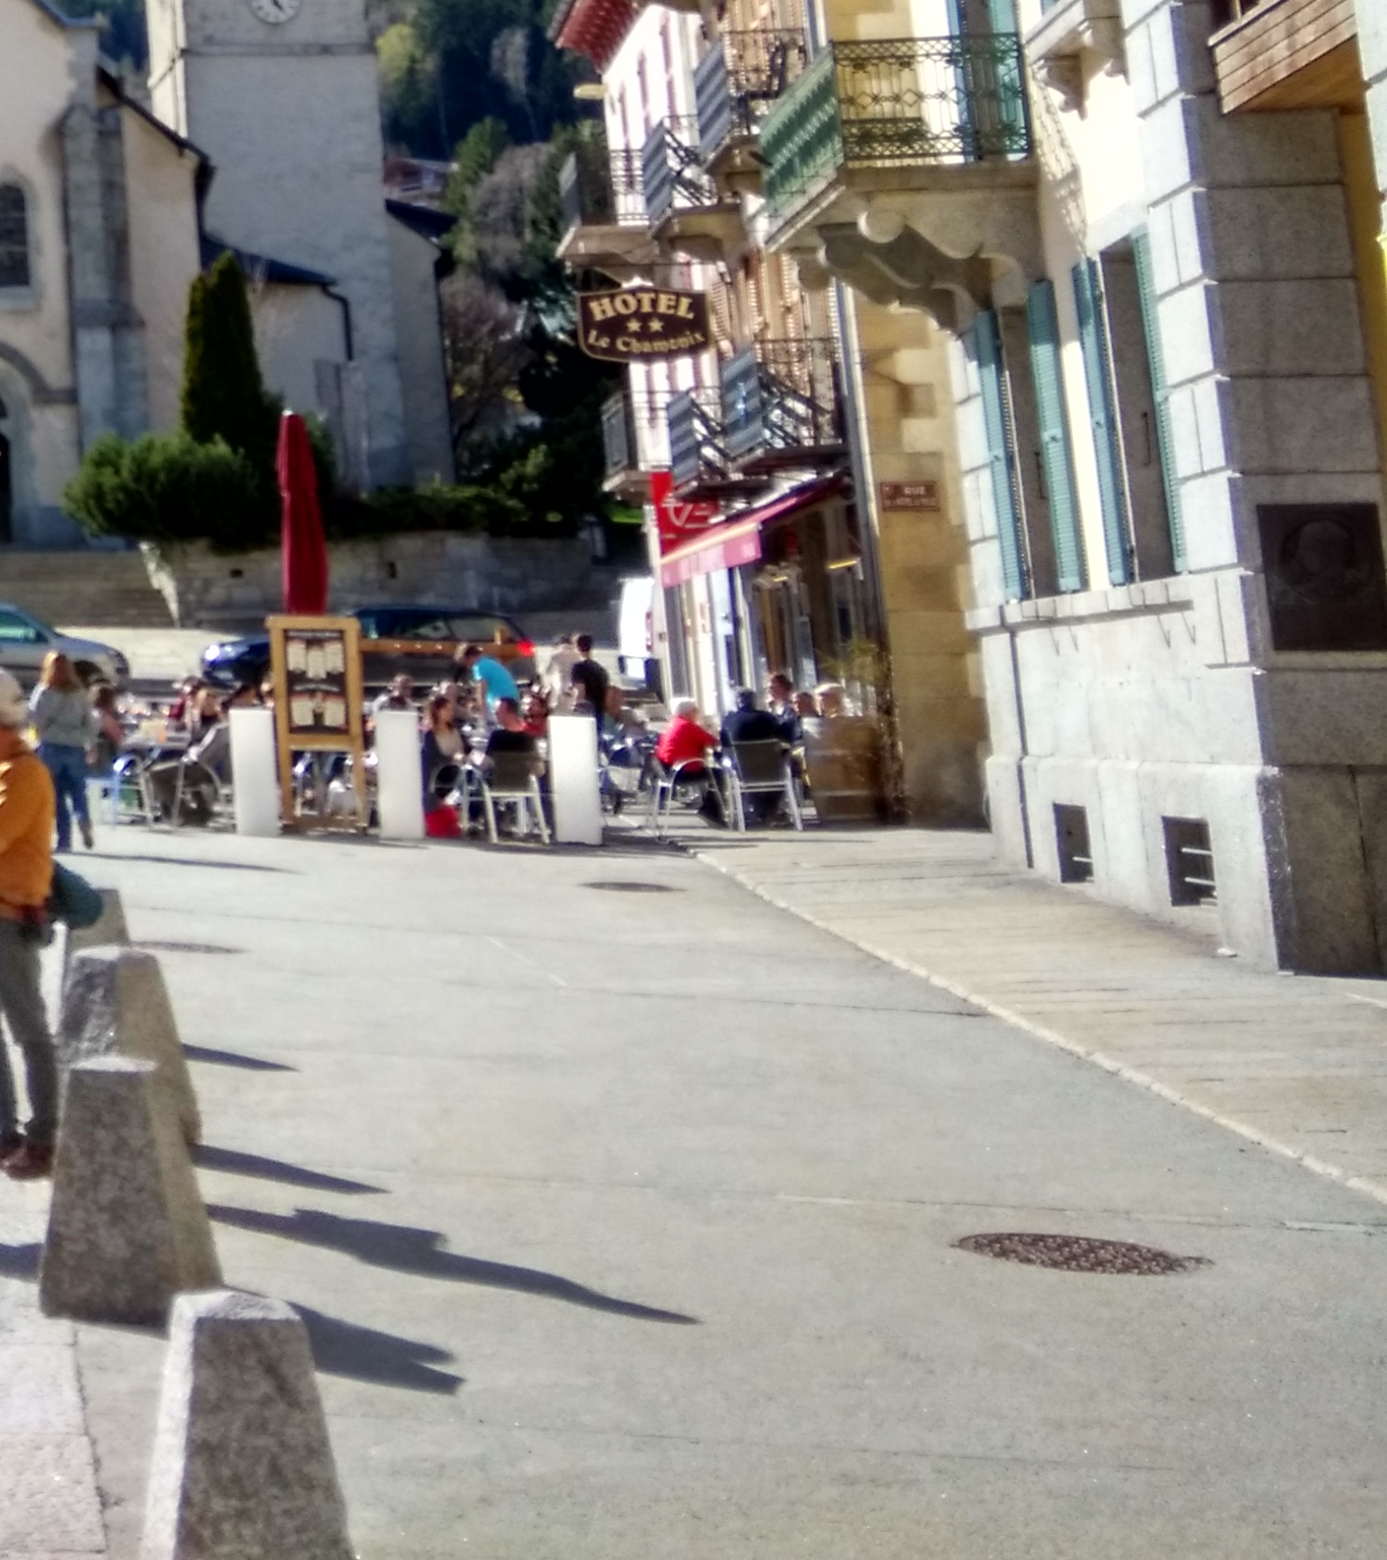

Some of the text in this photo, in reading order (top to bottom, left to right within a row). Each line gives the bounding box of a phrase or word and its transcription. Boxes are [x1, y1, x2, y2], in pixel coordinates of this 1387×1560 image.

[588, 291, 695, 322] HOTEL
[587, 329, 705, 354] Le Chamonix
